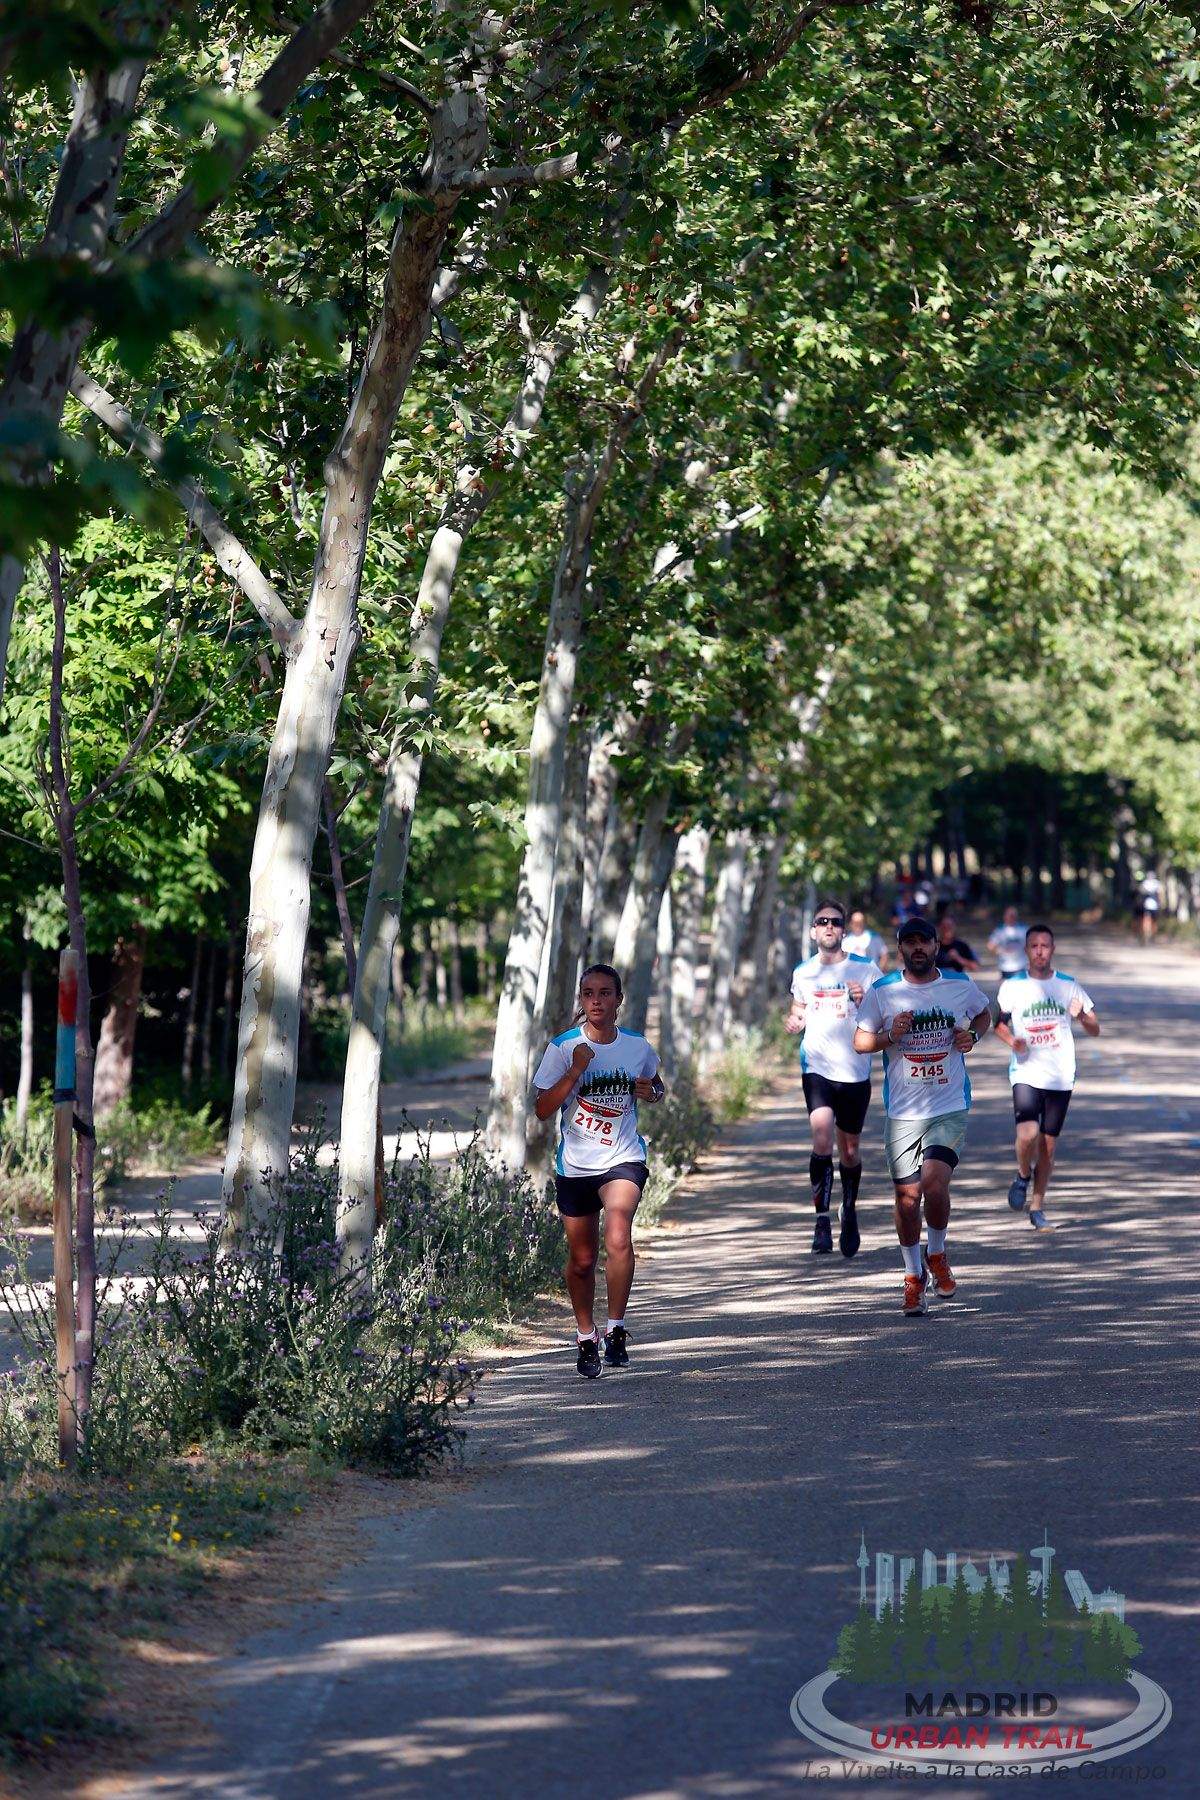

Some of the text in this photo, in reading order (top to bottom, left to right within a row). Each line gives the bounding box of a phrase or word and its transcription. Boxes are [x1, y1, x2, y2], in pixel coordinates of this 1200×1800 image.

[912, 1032, 943, 1040] MADRID
[1030, 1034, 1056, 1045] 2095
[911, 1065, 944, 1078] 2145
[592, 1096, 624, 1104] MADRID
[575, 1112, 613, 1135] 2178
